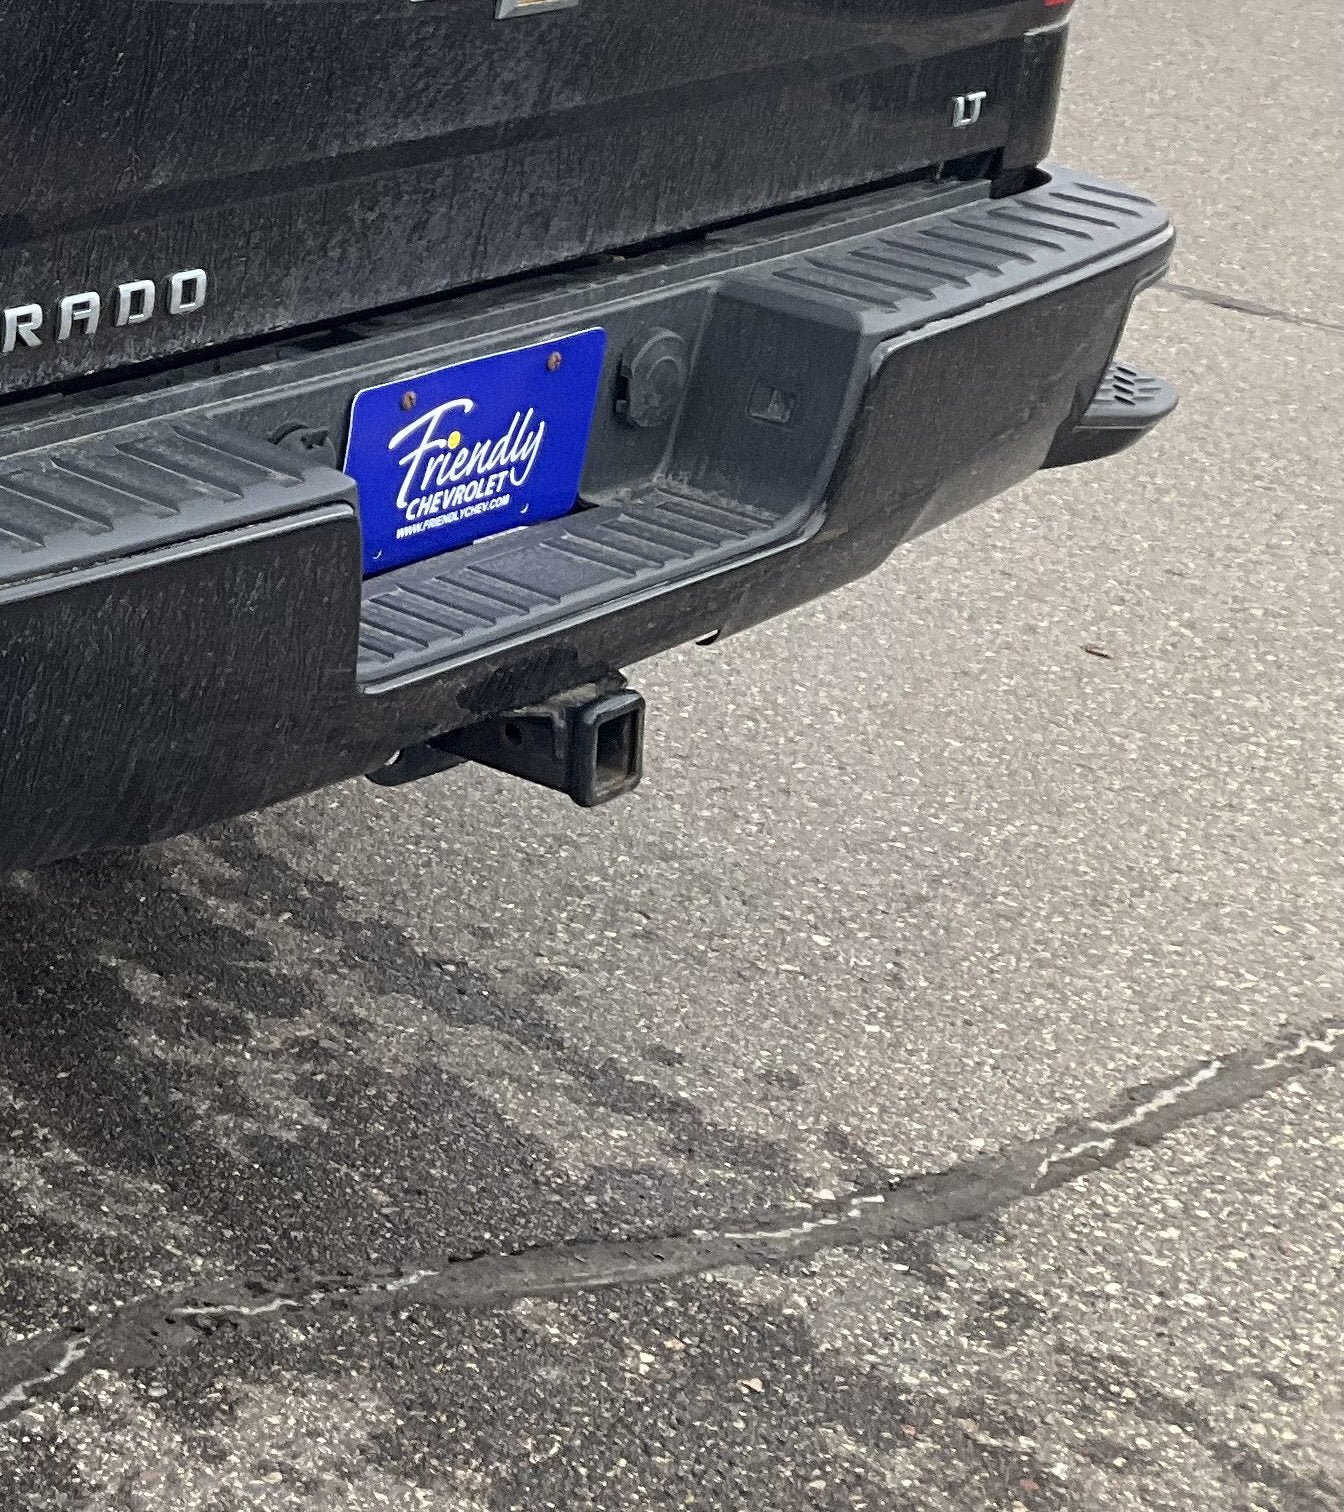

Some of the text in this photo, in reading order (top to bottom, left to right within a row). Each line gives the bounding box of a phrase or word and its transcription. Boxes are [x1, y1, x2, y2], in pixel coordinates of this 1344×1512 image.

[952, 90, 987, 128] LT
[387, 397, 546, 509] Friendly
[405, 470, 509, 521] CHEVROLET
